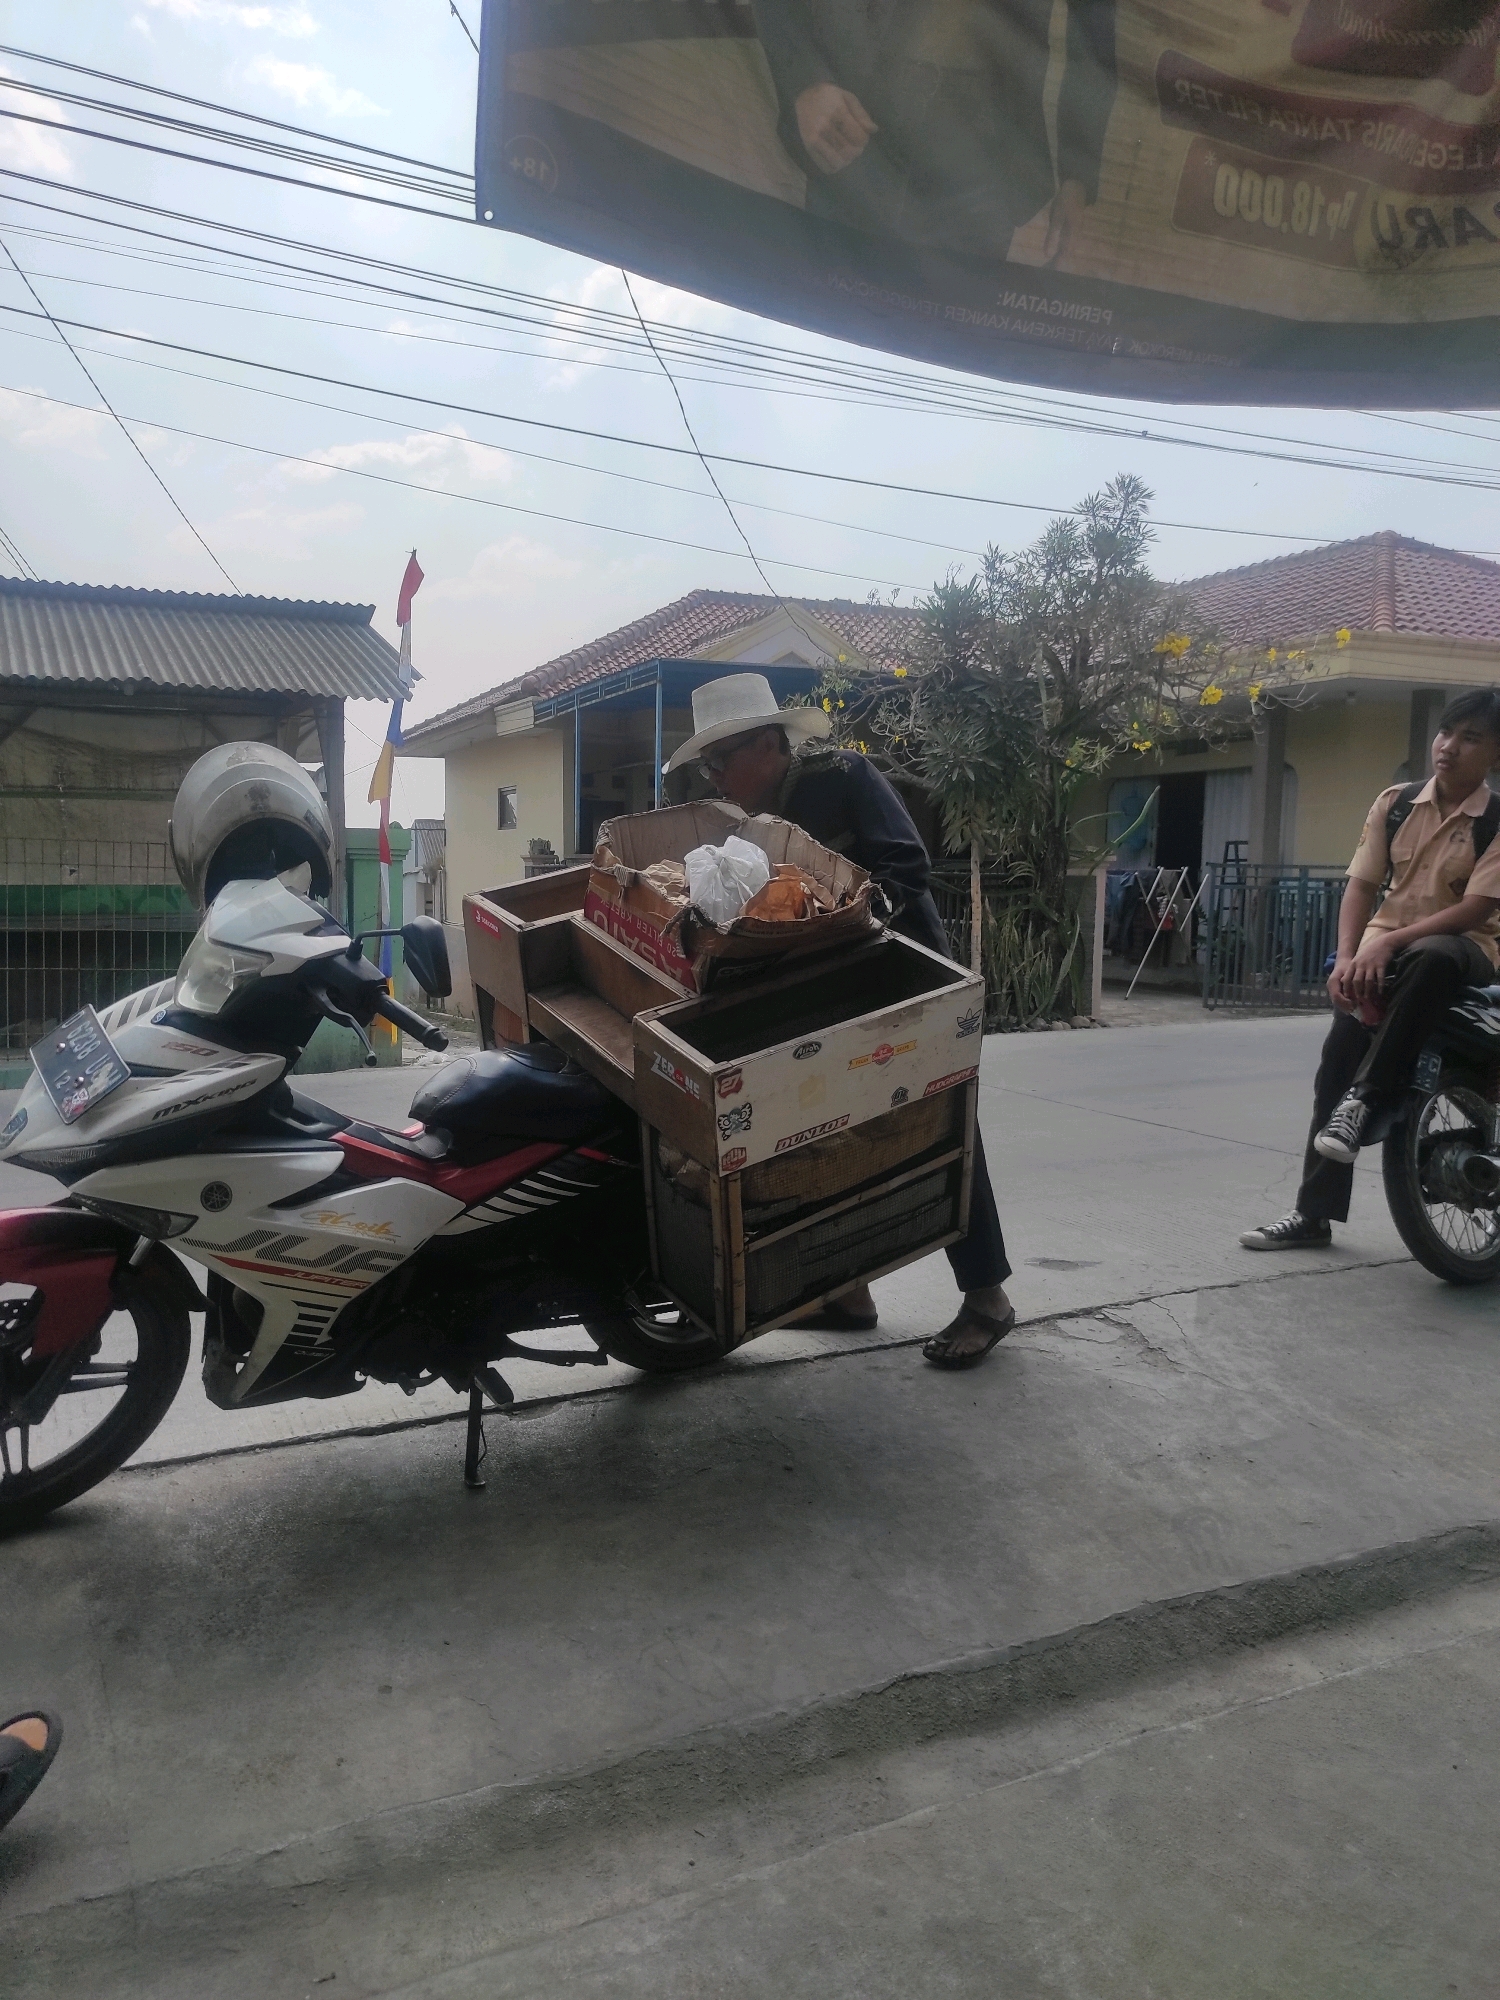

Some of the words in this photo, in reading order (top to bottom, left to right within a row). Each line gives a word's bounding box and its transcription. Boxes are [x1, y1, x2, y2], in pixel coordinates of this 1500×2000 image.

[66, 1020, 101, 1061] 6238
[775, 1114, 850, 1151] DUNLOP
[284, 1271, 373, 1289] JUPITER
